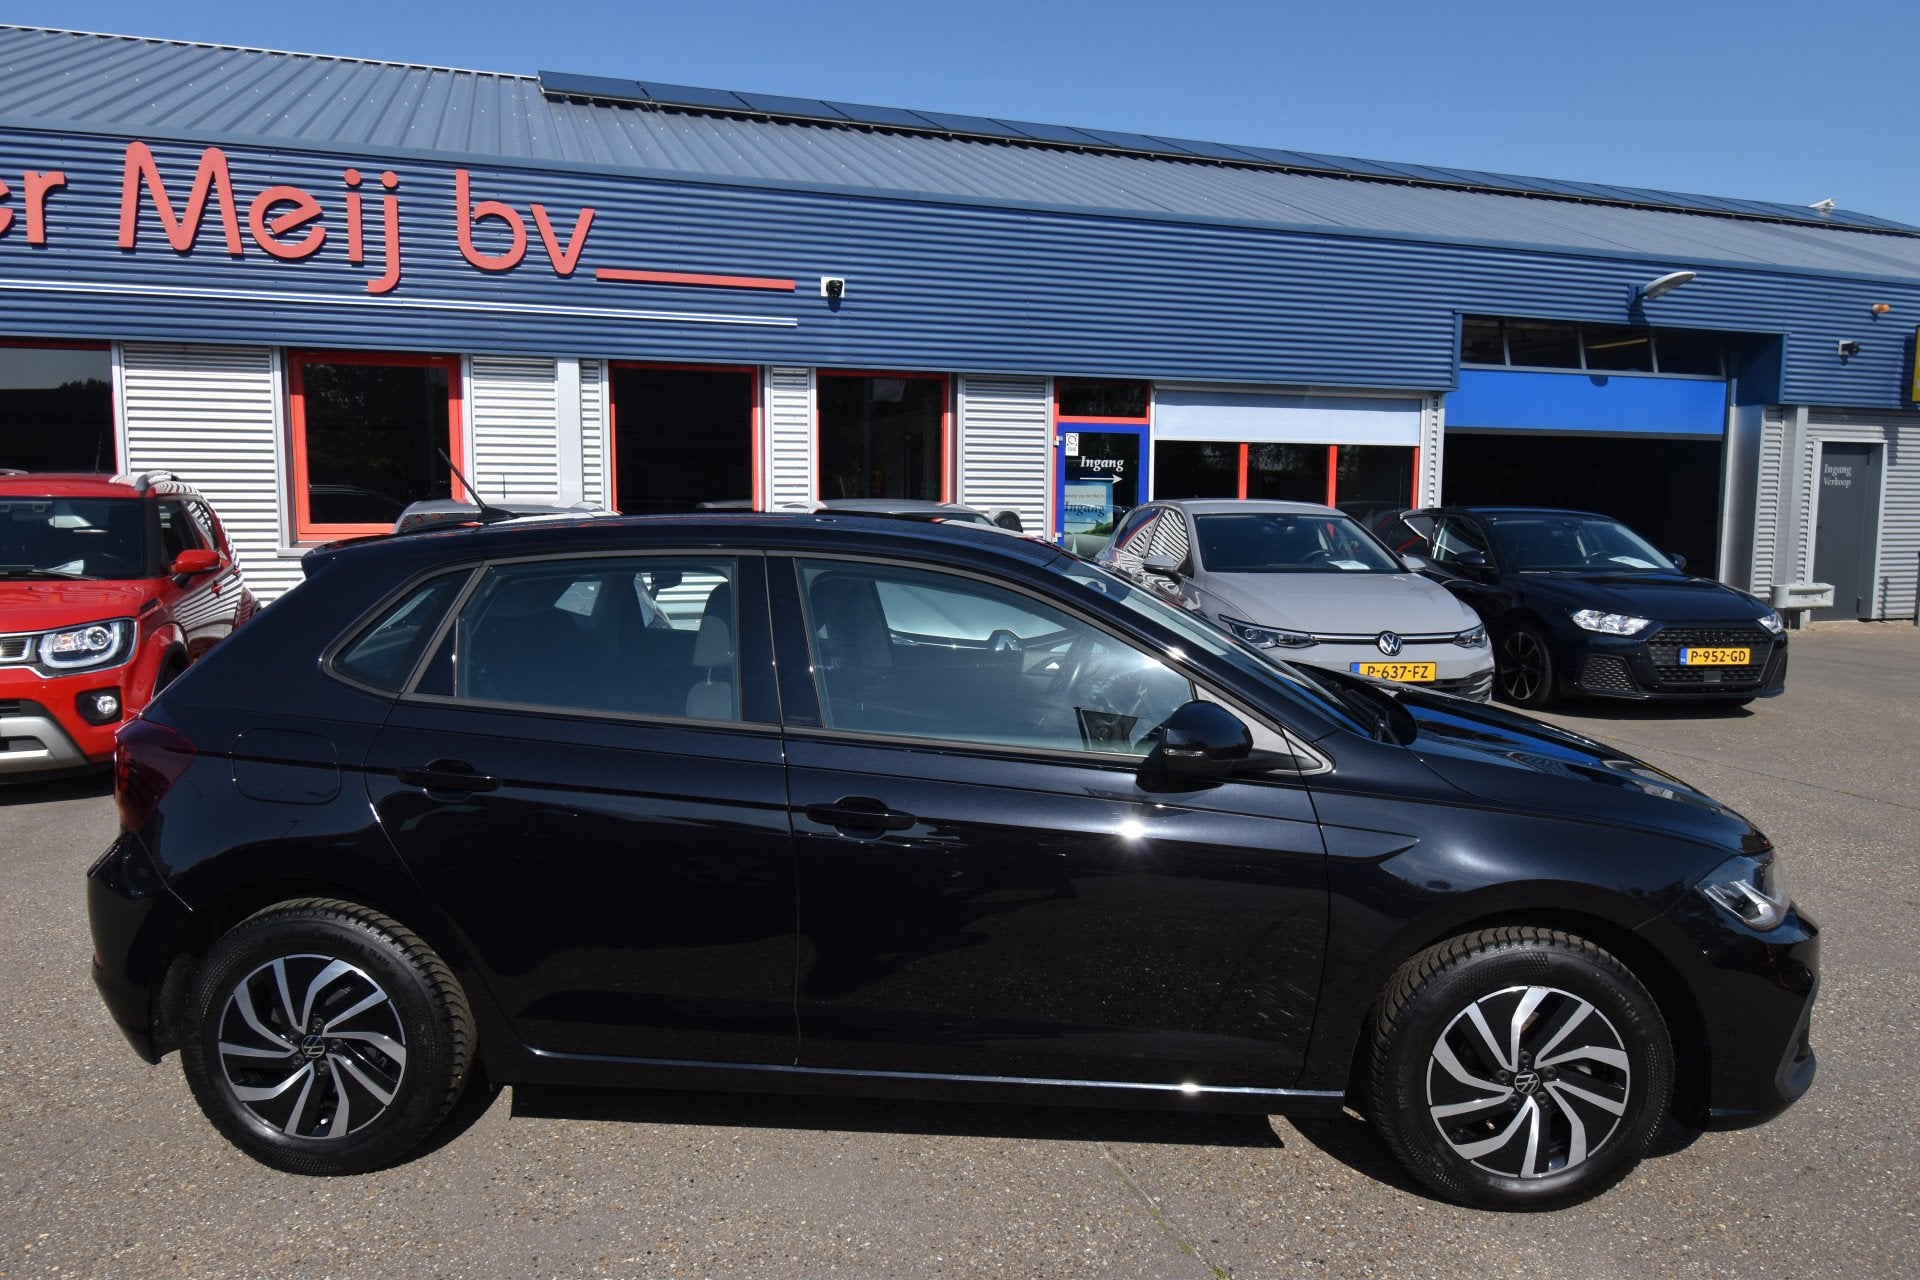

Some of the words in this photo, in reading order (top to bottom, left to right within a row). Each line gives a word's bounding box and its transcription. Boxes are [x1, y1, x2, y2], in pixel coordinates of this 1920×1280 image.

[0, 170, 65, 244] r
[118, 141, 399, 293] Meij
[455, 169, 595, 275] bv
[1080, 455, 1124, 472] Ingang
[1824, 463, 1852, 477] Ingang
[1824, 477, 1851, 489] Verkoop
[1690, 650, 1746, 663] P-952-GD
[1367, 665, 1429, 680] P-637-FZ
